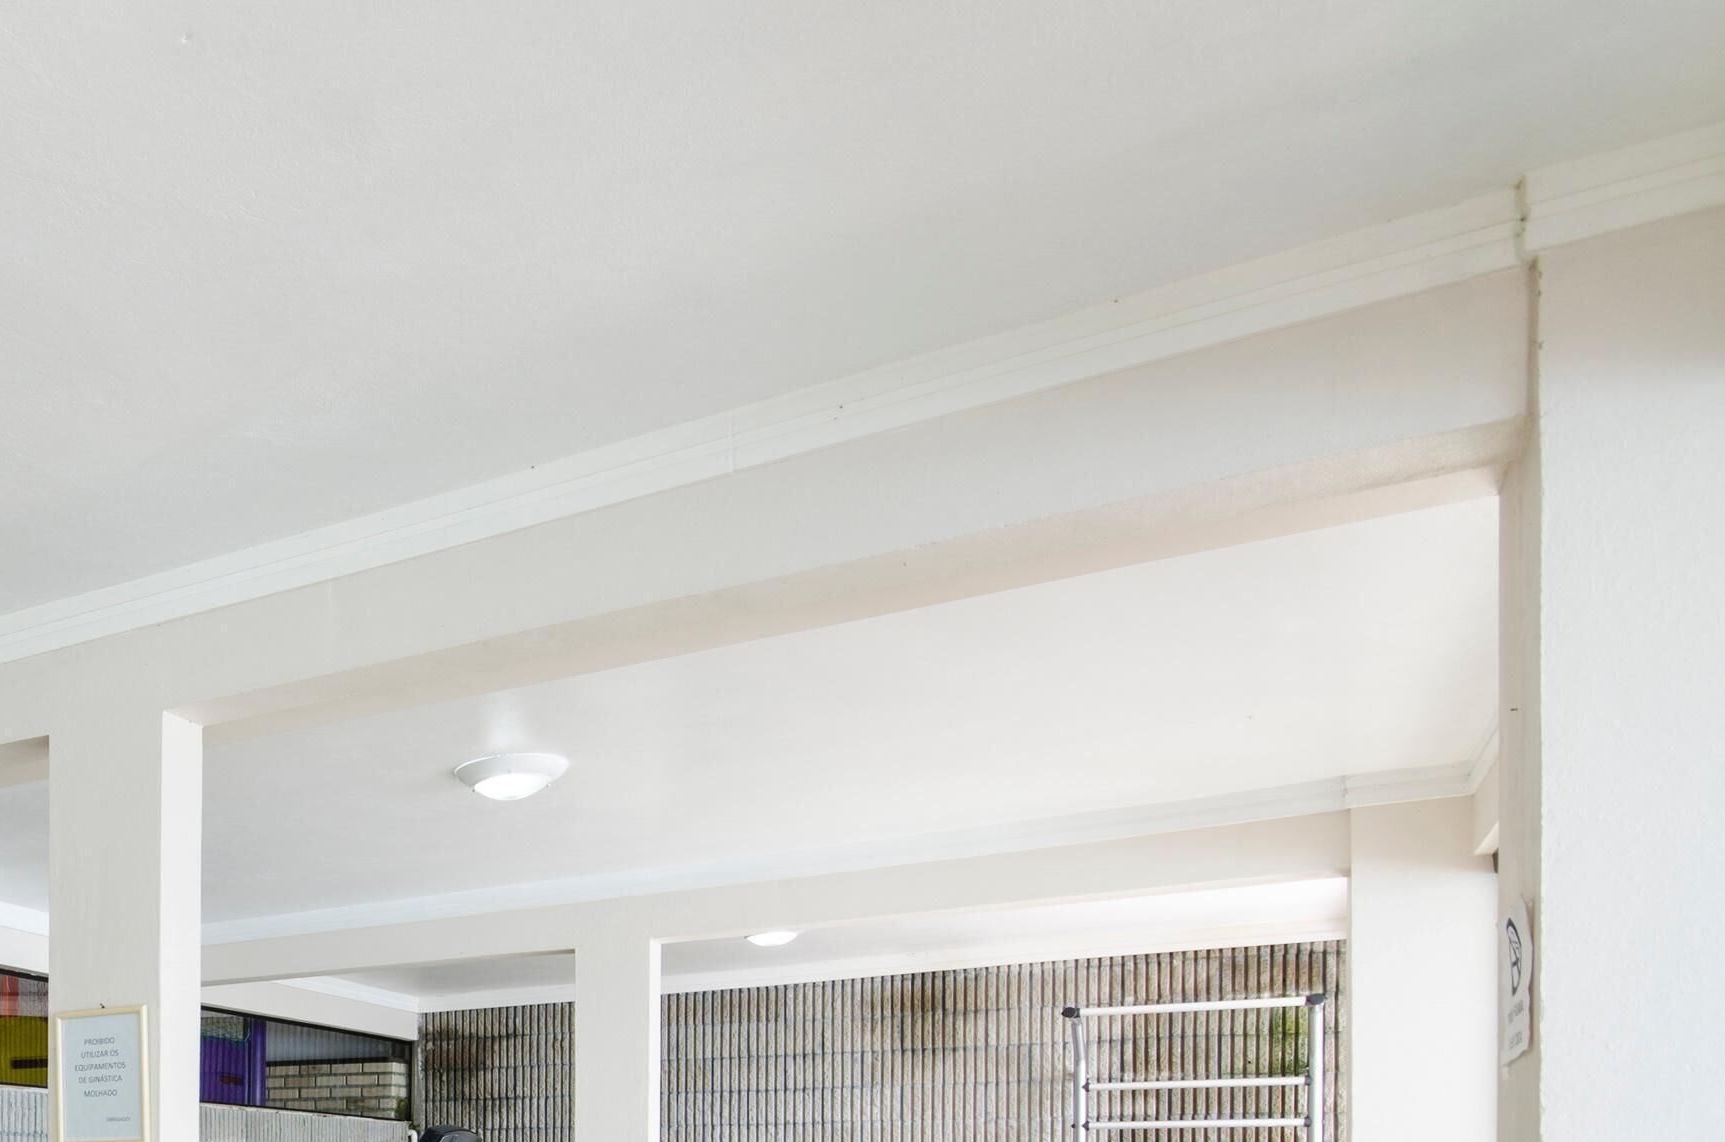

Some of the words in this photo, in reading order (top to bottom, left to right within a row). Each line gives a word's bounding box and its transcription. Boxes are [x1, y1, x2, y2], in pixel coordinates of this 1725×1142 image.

[83, 1037, 115, 1046] PROIBIDO
[80, 1050, 108, 1059] UTILIZAR
[109, 1049, 120, 1057] OS
[74, 1062, 126, 1071] EQUIPAMENTOS
[78, 1076, 88, 1084] DE
[83, 1089, 117, 1097] MOLHADO
